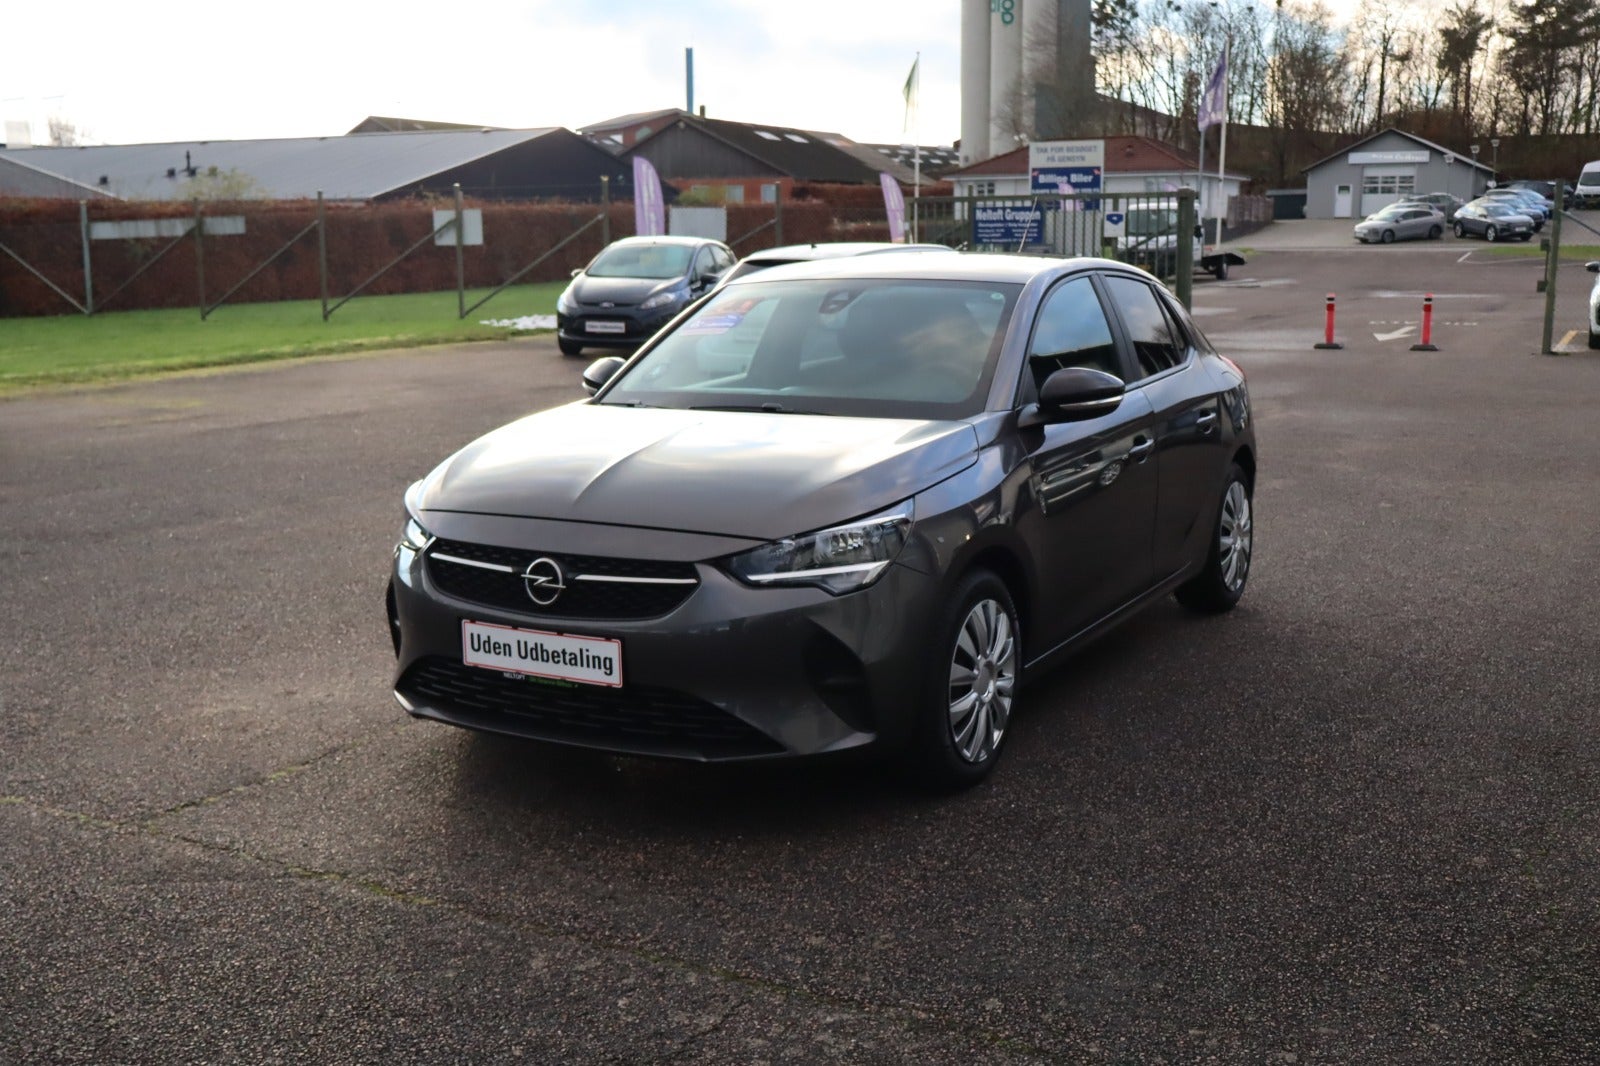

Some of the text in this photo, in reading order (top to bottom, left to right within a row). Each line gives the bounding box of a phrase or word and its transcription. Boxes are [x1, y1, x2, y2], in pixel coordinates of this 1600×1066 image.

[1039, 173, 1093, 184] Billige Biler
[976, 209, 1041, 222] Neltoft Gruppen
[470, 632, 613, 676] Uden Udbetaling
